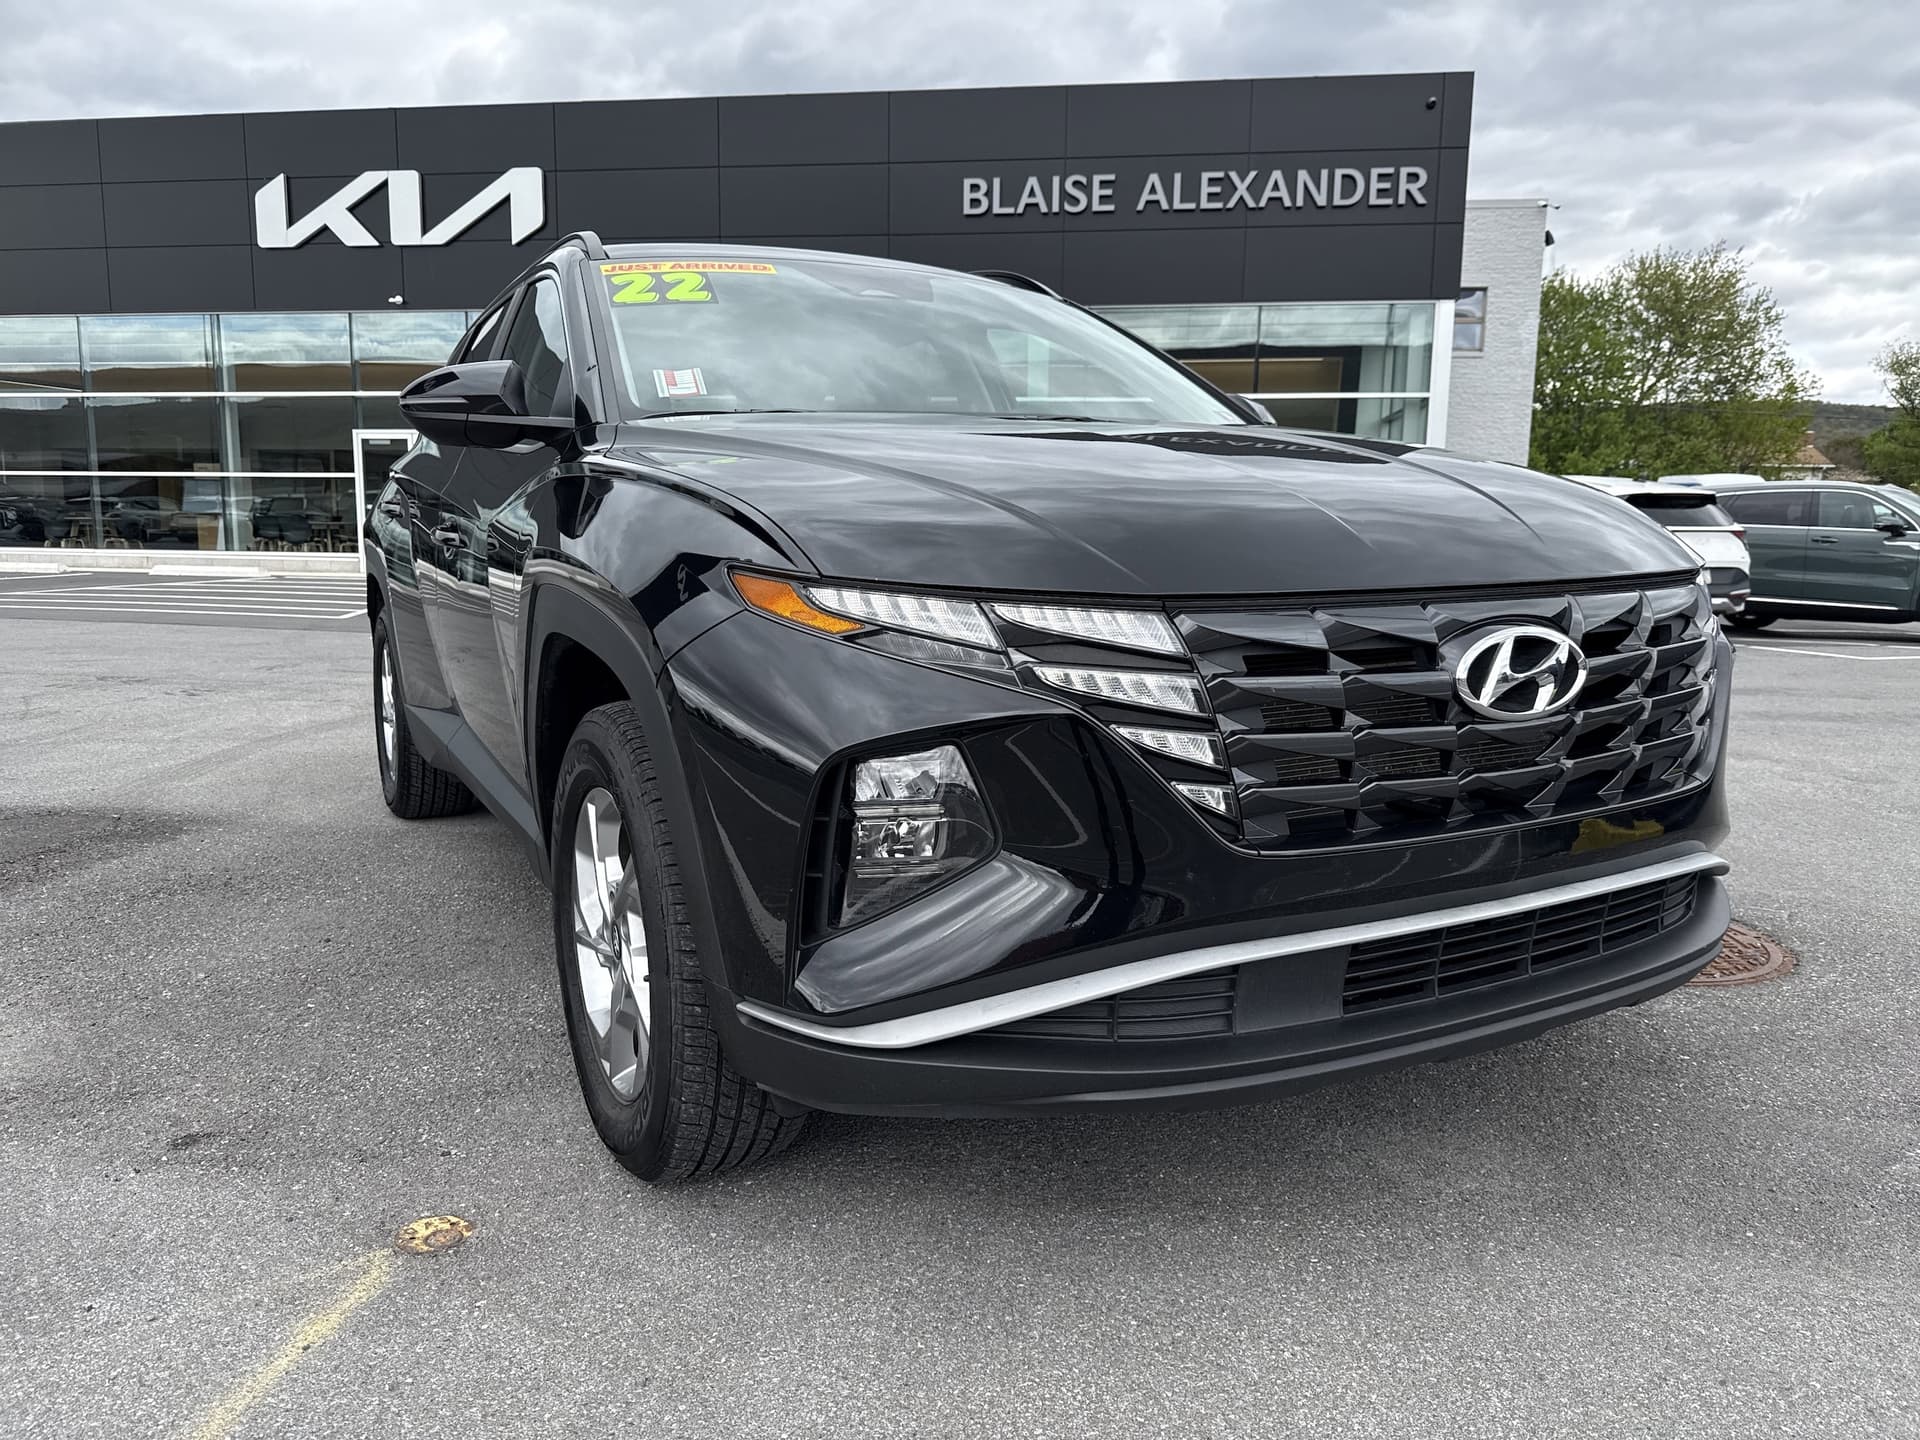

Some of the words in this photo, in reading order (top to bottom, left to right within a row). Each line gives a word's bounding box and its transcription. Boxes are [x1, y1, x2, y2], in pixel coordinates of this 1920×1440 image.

[254, 166, 545, 248] KIA
[962, 173, 1117, 216] BLAISE
[1135, 165, 1430, 213] ALEXANDER
[603, 263, 666, 273] JUST
[669, 262, 772, 272] ARRIVED
[610, 272, 712, 304] 22
